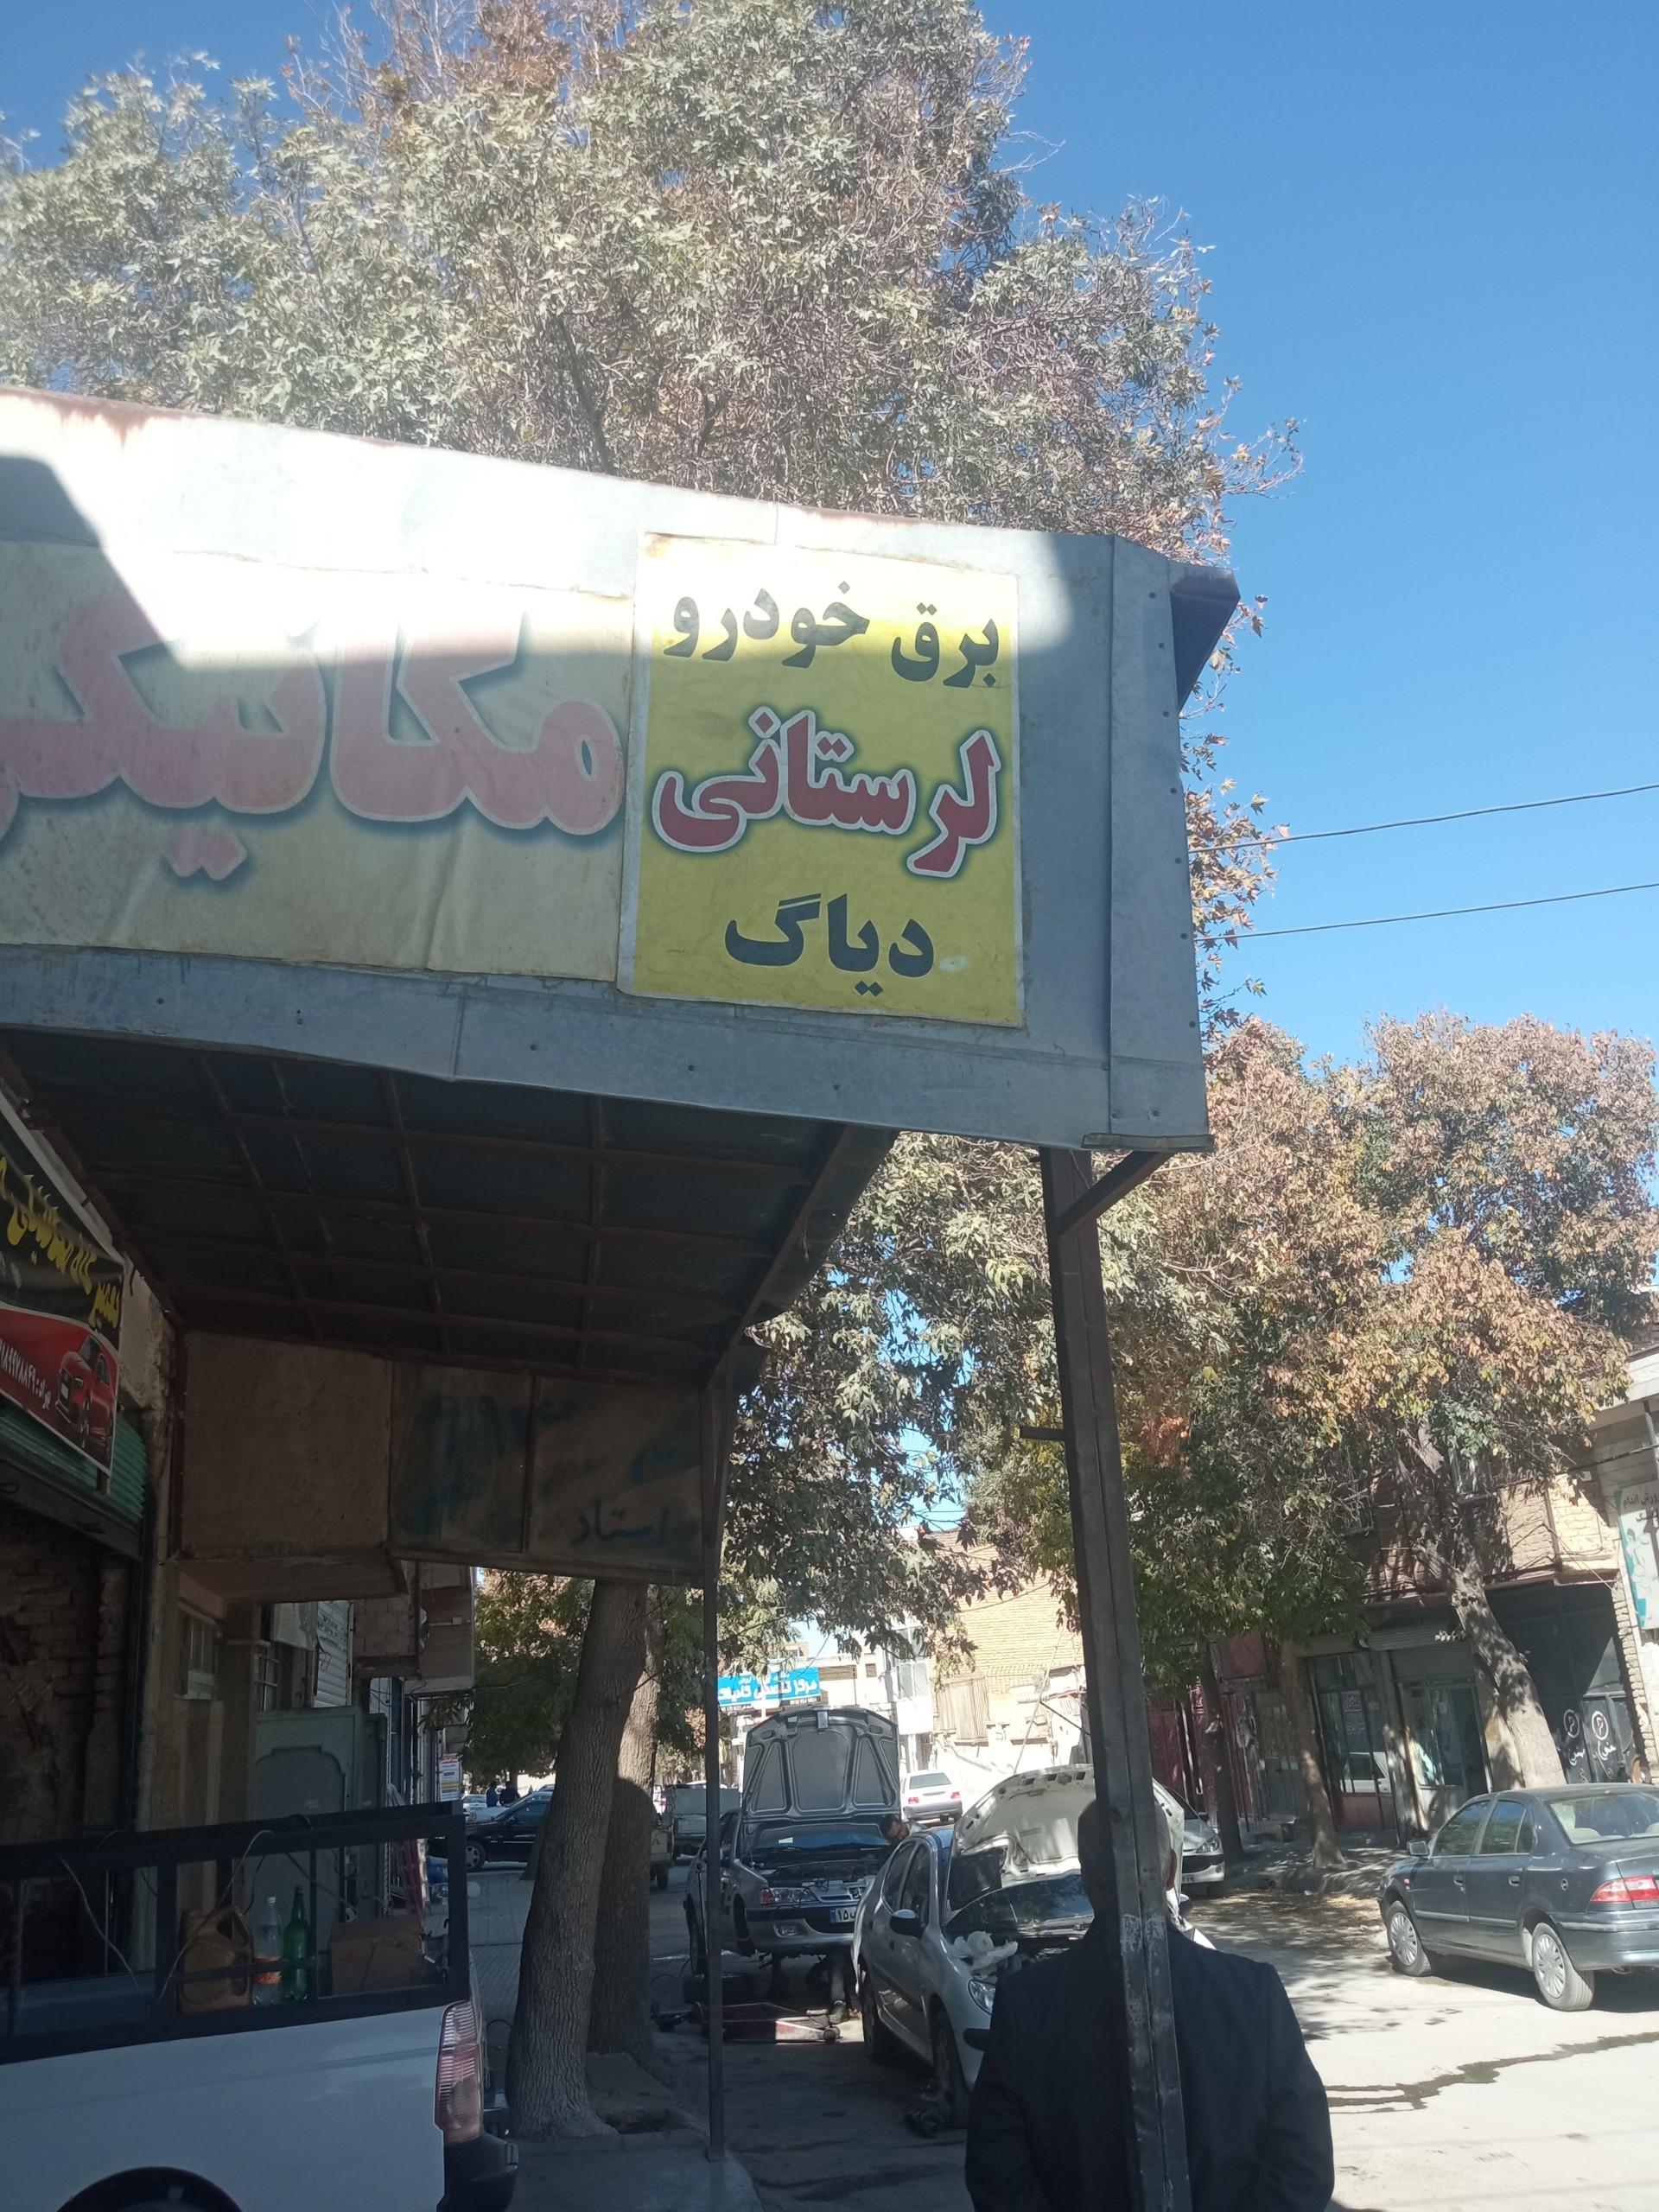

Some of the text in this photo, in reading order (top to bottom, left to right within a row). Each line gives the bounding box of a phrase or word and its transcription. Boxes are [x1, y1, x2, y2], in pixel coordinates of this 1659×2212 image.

[664, 581, 999, 689] برق خودرو
[0, 596, 624, 880] مکانیک
[652, 706, 1001, 877] لرستانی
[725, 893, 934, 996] دیاگ
